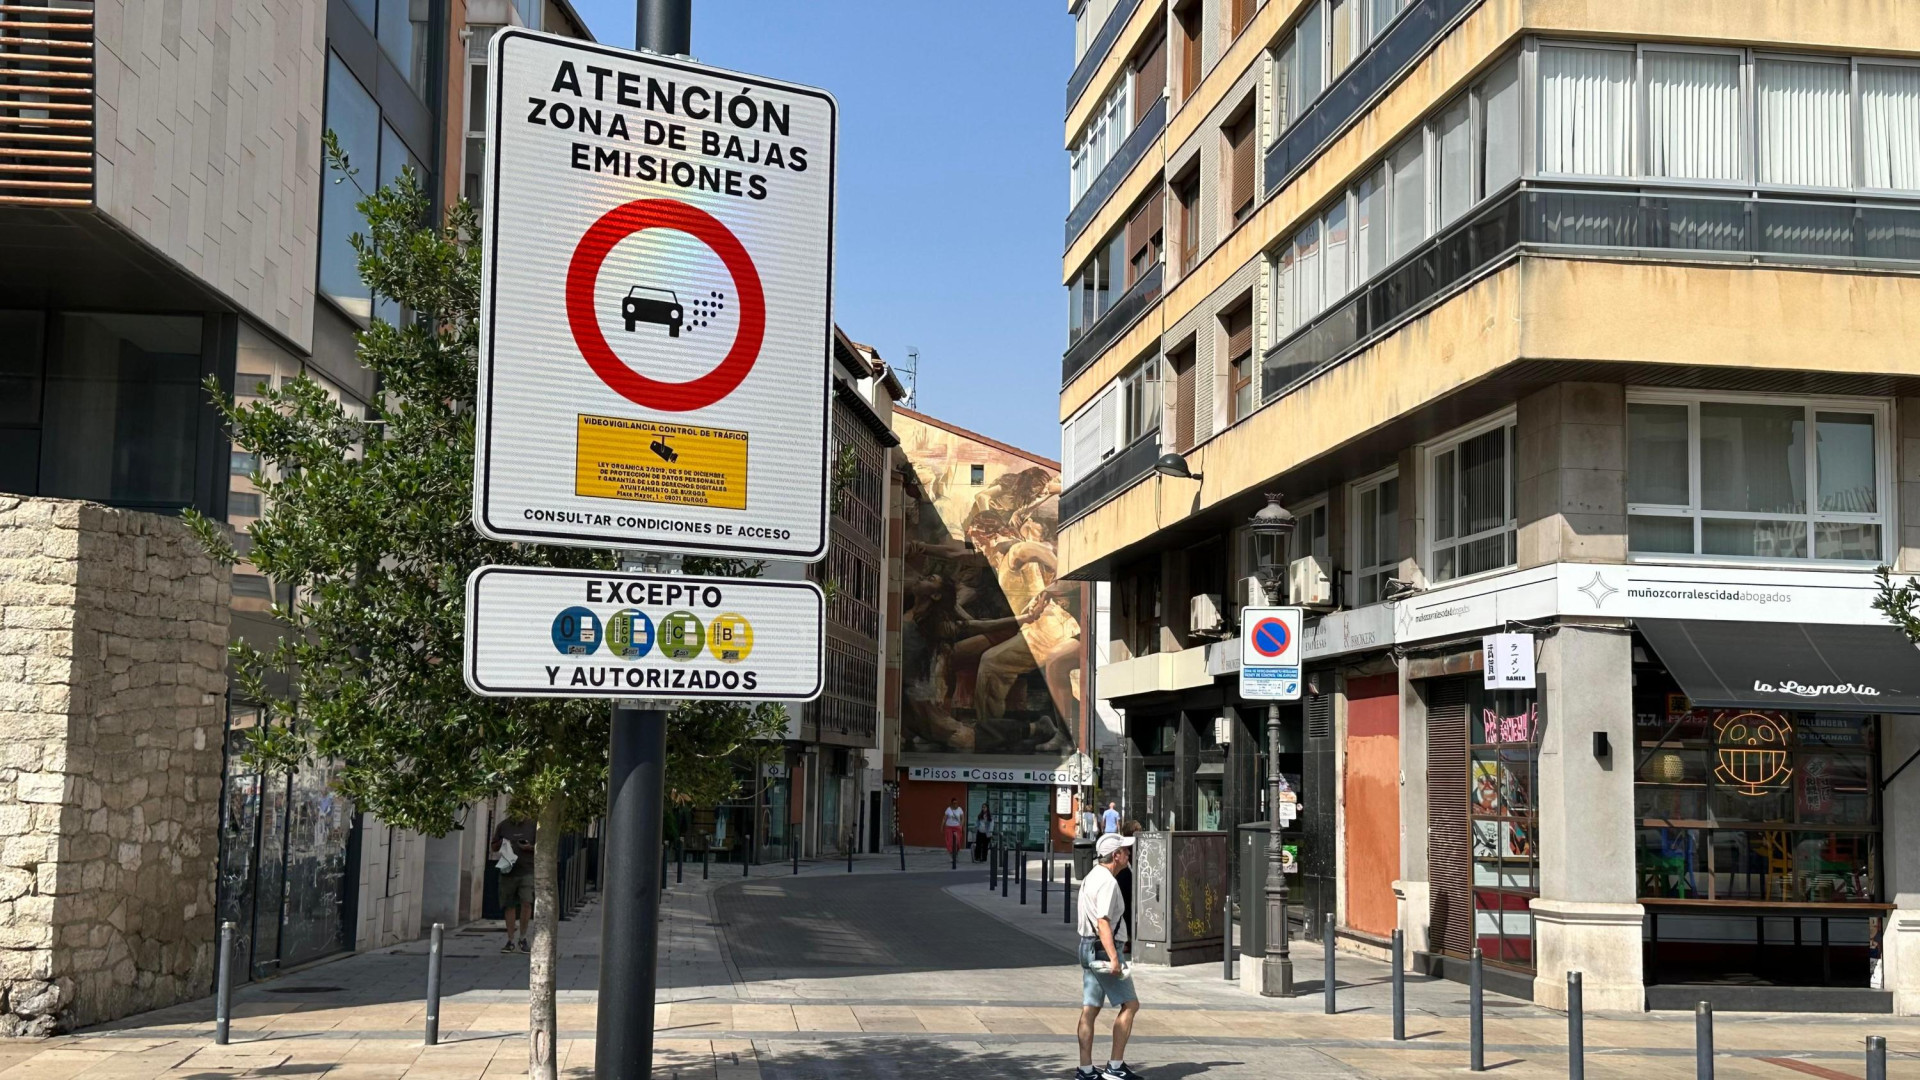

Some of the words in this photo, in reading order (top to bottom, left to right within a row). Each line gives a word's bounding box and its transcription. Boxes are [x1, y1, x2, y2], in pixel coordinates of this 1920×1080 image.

[551, 60, 790, 136] ATENCIÓN
[527, 97, 630, 141] ZONA
[643, 119, 687, 151] DE
[701, 130, 808, 172] BAJAS
[571, 142, 767, 200] EMISIONES
[583, 417, 656, 432] VIDEOVIGILANCIA
[658, 425, 698, 436] CONTROL
[699, 429, 711, 438] DE
[713, 431, 748, 442] TRÁFICO
[661, 474, 683, 482] DATOS
[684, 476, 725, 486] PERSONALES
[668, 467, 677, 475] DE
[523, 508, 612, 527] CONSULTAR
[616, 514, 712, 535] CONDICIONES
[716, 522, 733, 537] DE
[737, 525, 791, 541] ACCESO
[586, 580, 722, 608] EXCEPTO
[672, 625, 684, 640] C
[722, 627, 733, 641] B
[1510, 643, 1520, 675] ラーメン
[545, 666, 561, 687] Y
[570, 666, 758, 691] AUTORIZADOS
[922, 767, 957, 780] Pisos
[971, 768, 1015, 781] Casas
[1032, 770, 1088, 783] Locale
